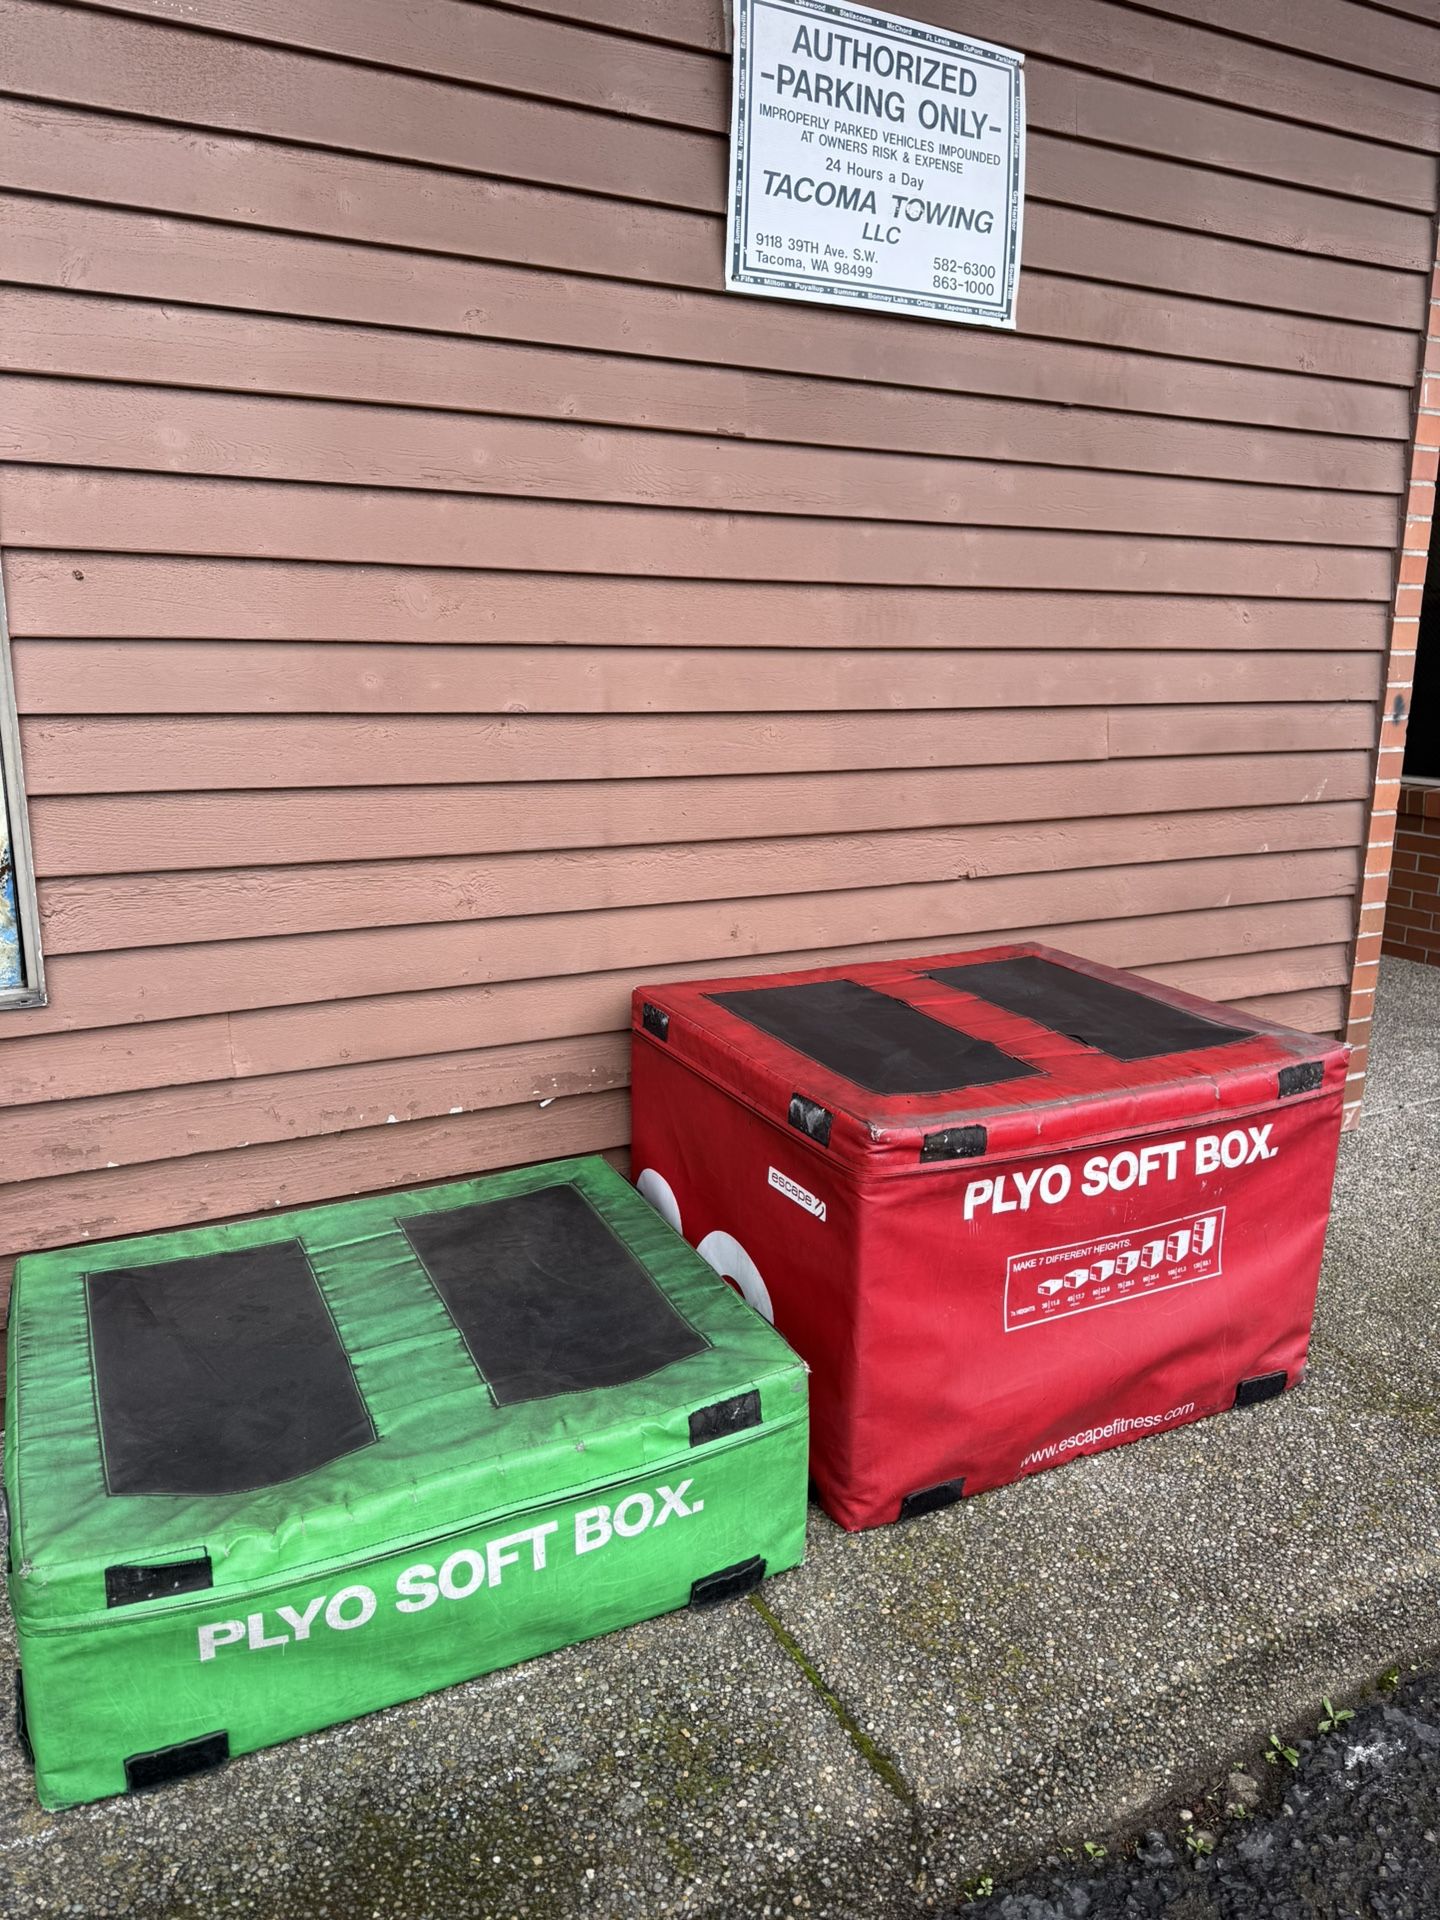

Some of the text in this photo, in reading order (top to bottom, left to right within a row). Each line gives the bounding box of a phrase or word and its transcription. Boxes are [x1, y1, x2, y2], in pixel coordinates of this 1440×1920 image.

[886, 22, 913, 35] McChord
[963, 44, 984, 56] DuPont
[792, 24, 978, 98] AUTHORIZED
[759, 103, 1001, 166] IMPROPERLY PARKED VEHICLES IMPOUNDED
[800, 131, 964, 175] AT OWNERS RISK & EXPENSE
[825, 157, 924, 190] 24 Hours a Day
[762, 169, 994, 234] TACOMA TOWING
[755, 233, 878, 264] 9118 39TH Ave. S.W.
[862, 222, 901, 245] LLC
[755, 250, 873, 279] Tacoma, WA 98499
[932, 257, 996, 278] 582-6300
[740, 275, 754, 284] Fife
[764, 278, 786, 288] Milton
[794, 282, 824, 293] Puyallup
[833, 288, 859, 297] Sumner
[867, 292, 891, 303] Bonney
[893, 295, 909, 304] Lake
[916, 299, 935, 310] Orting
[932, 275, 995, 296] 863-1000
[962, 1123, 1279, 1220] PLYO SOFT BOX.
[771, 1172, 812, 1206] escape
[1012, 1239, 1132, 1272] MAKE 7 DIFFERENT HEIGHTS.
[198, 1478, 705, 1662] PLYO SOFT BOX.
